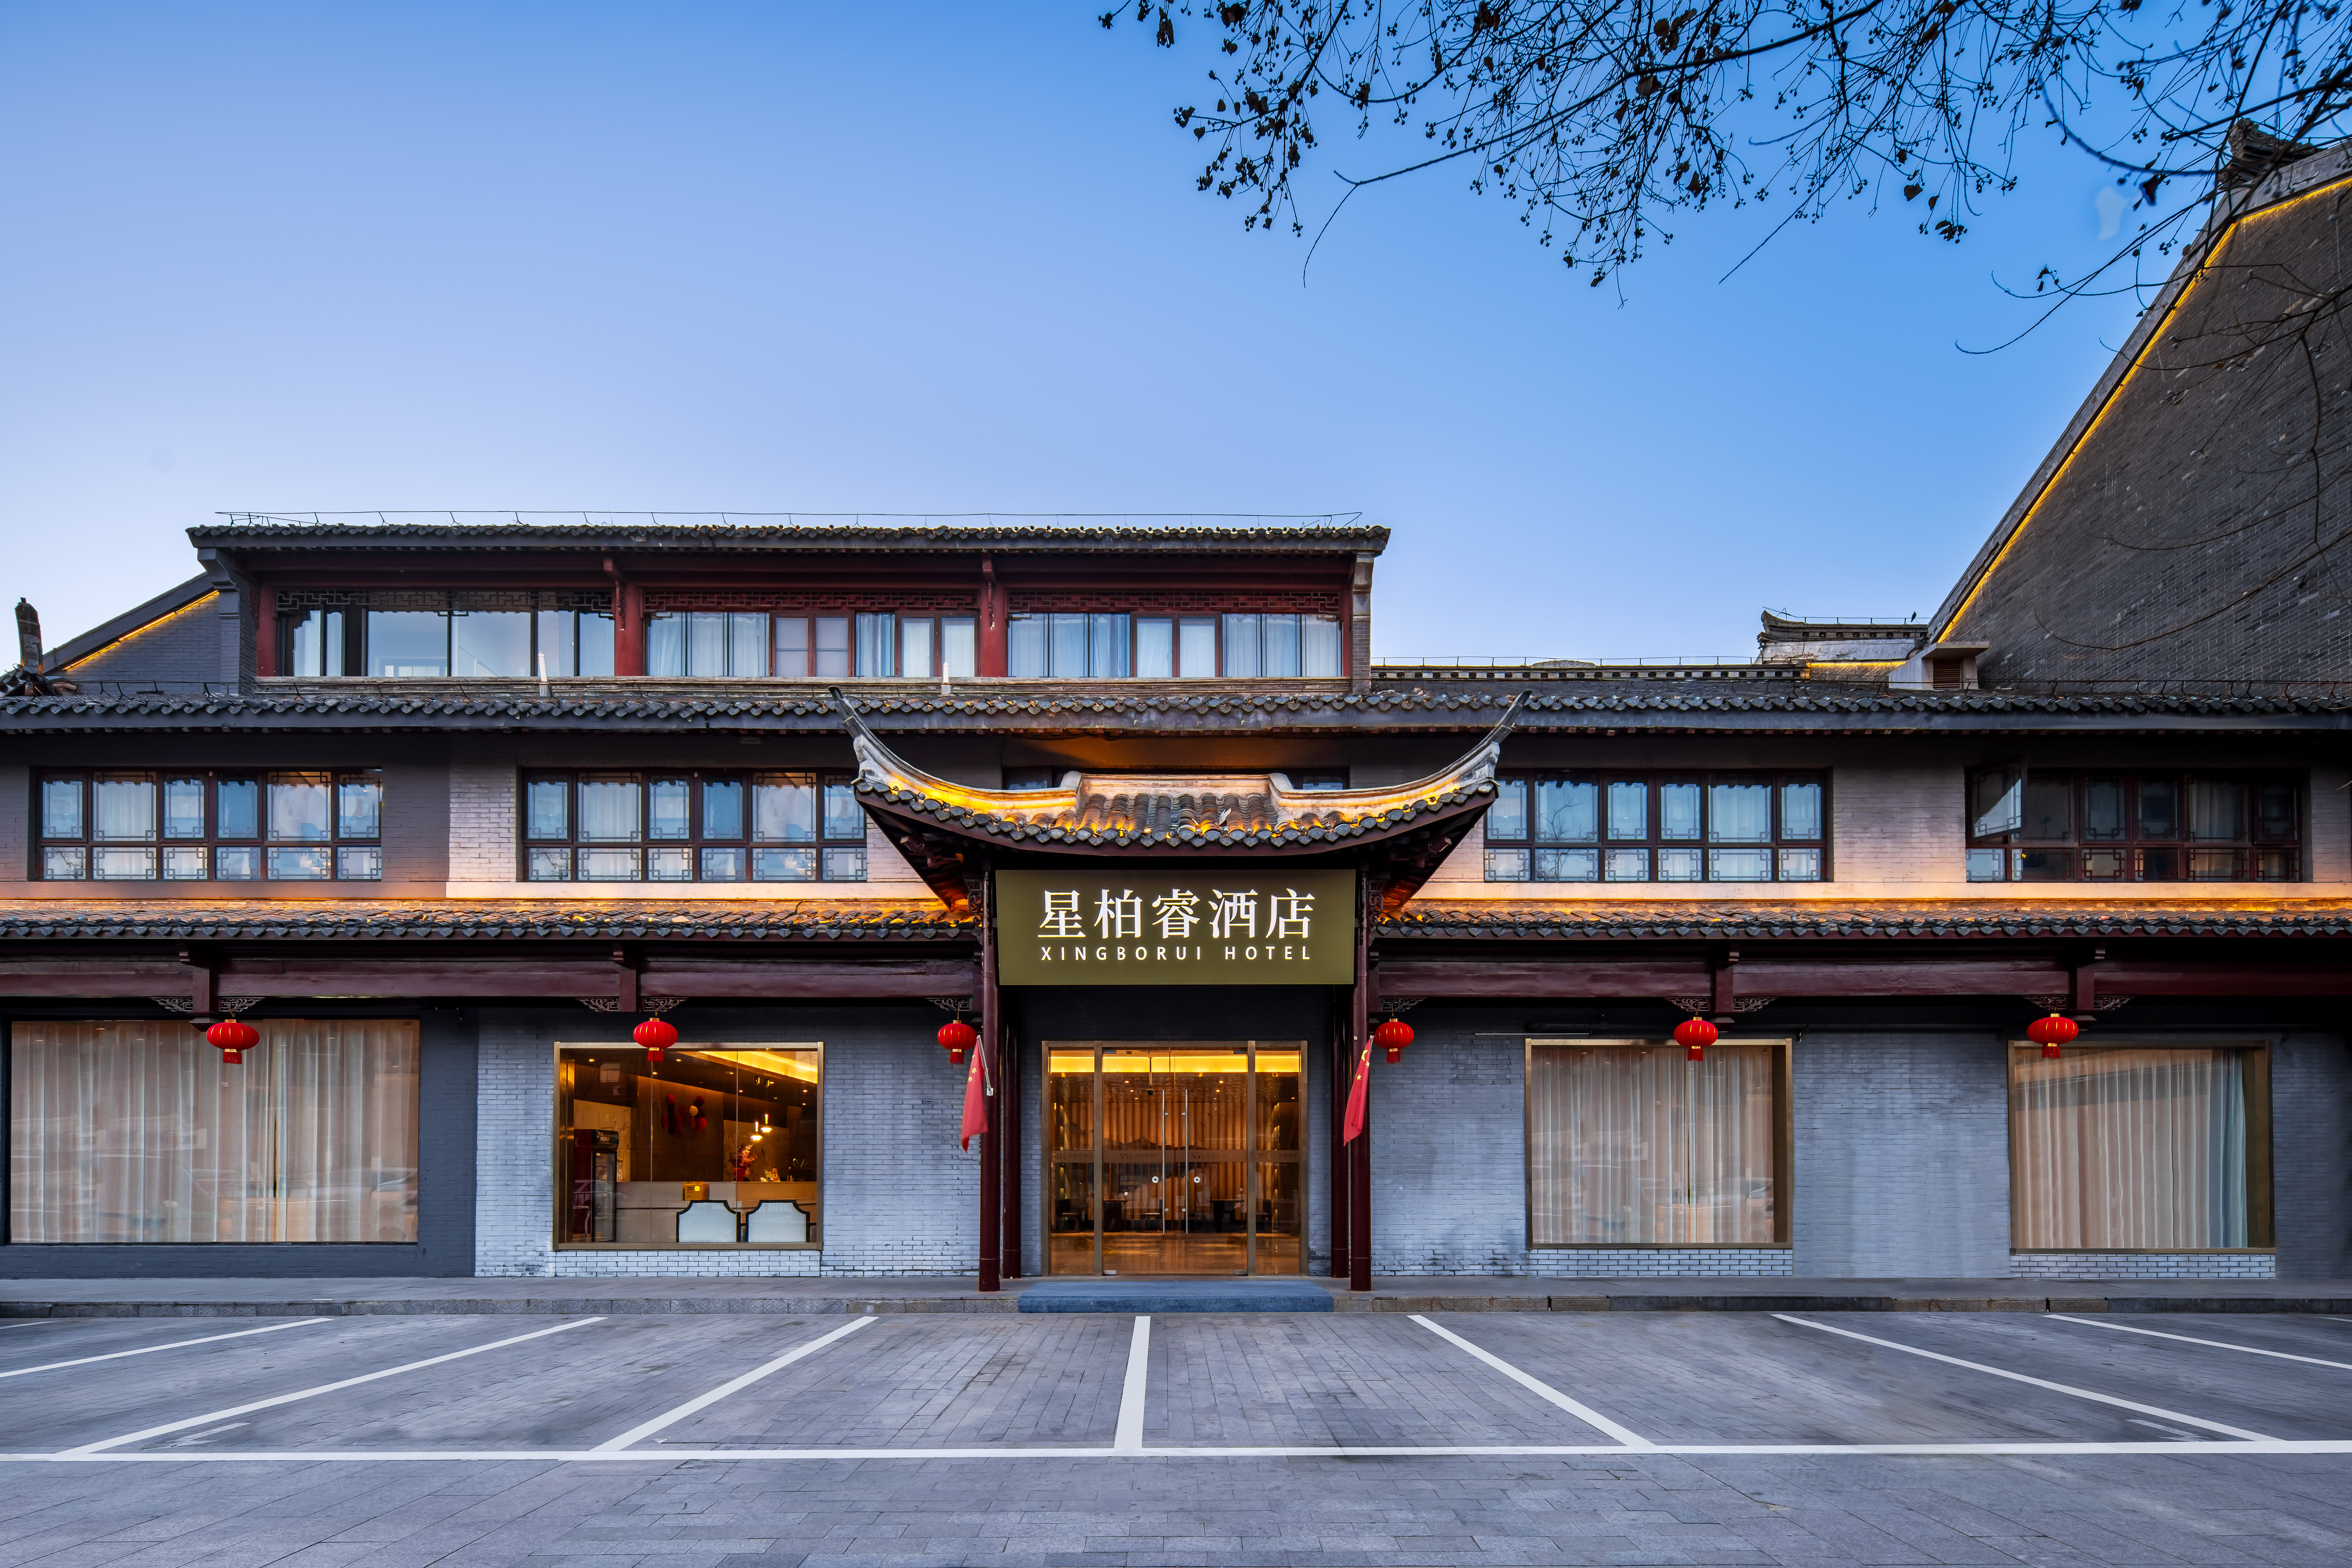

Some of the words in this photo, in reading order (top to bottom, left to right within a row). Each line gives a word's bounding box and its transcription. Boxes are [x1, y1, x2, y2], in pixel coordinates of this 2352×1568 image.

[1038, 888, 1315, 939] 星柏睿酒店
[1041, 946, 1200, 960] XINGBORUI
[1225, 946, 1310, 960] HOTEL
